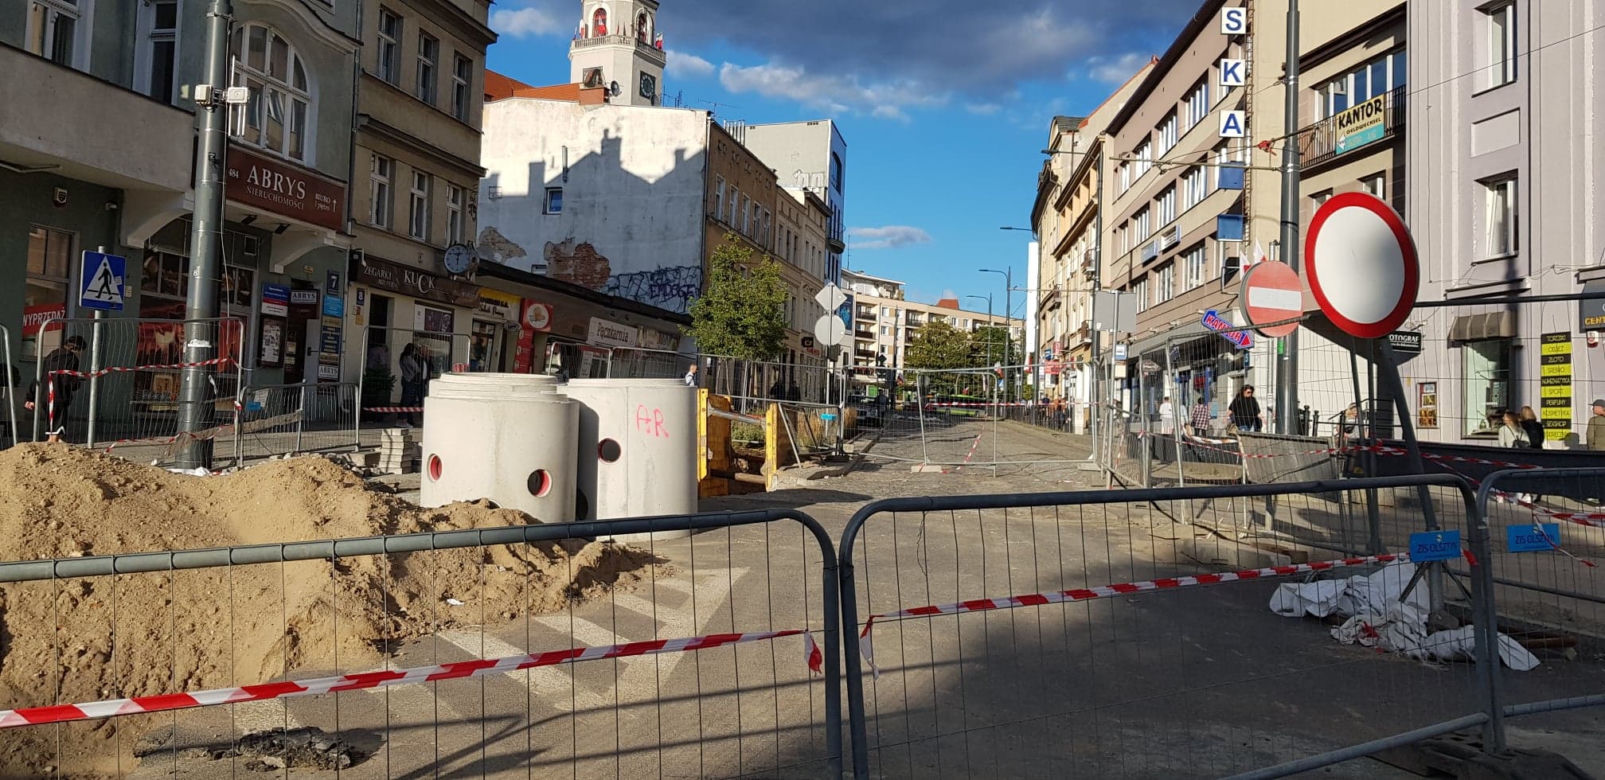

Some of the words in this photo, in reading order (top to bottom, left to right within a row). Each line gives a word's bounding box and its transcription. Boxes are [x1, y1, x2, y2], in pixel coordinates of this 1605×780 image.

[1338, 98, 1382, 130] KANTOR
[247, 165, 306, 200] ABRYS
[331, 275, 337, 289] 7
[404, 269, 435, 294] KUCK
[23, 306, 66, 327] WYPRZEDAŻ
[1389, 333, 1419, 343] OTOGRAF
[635, 402, 670, 439] AR
